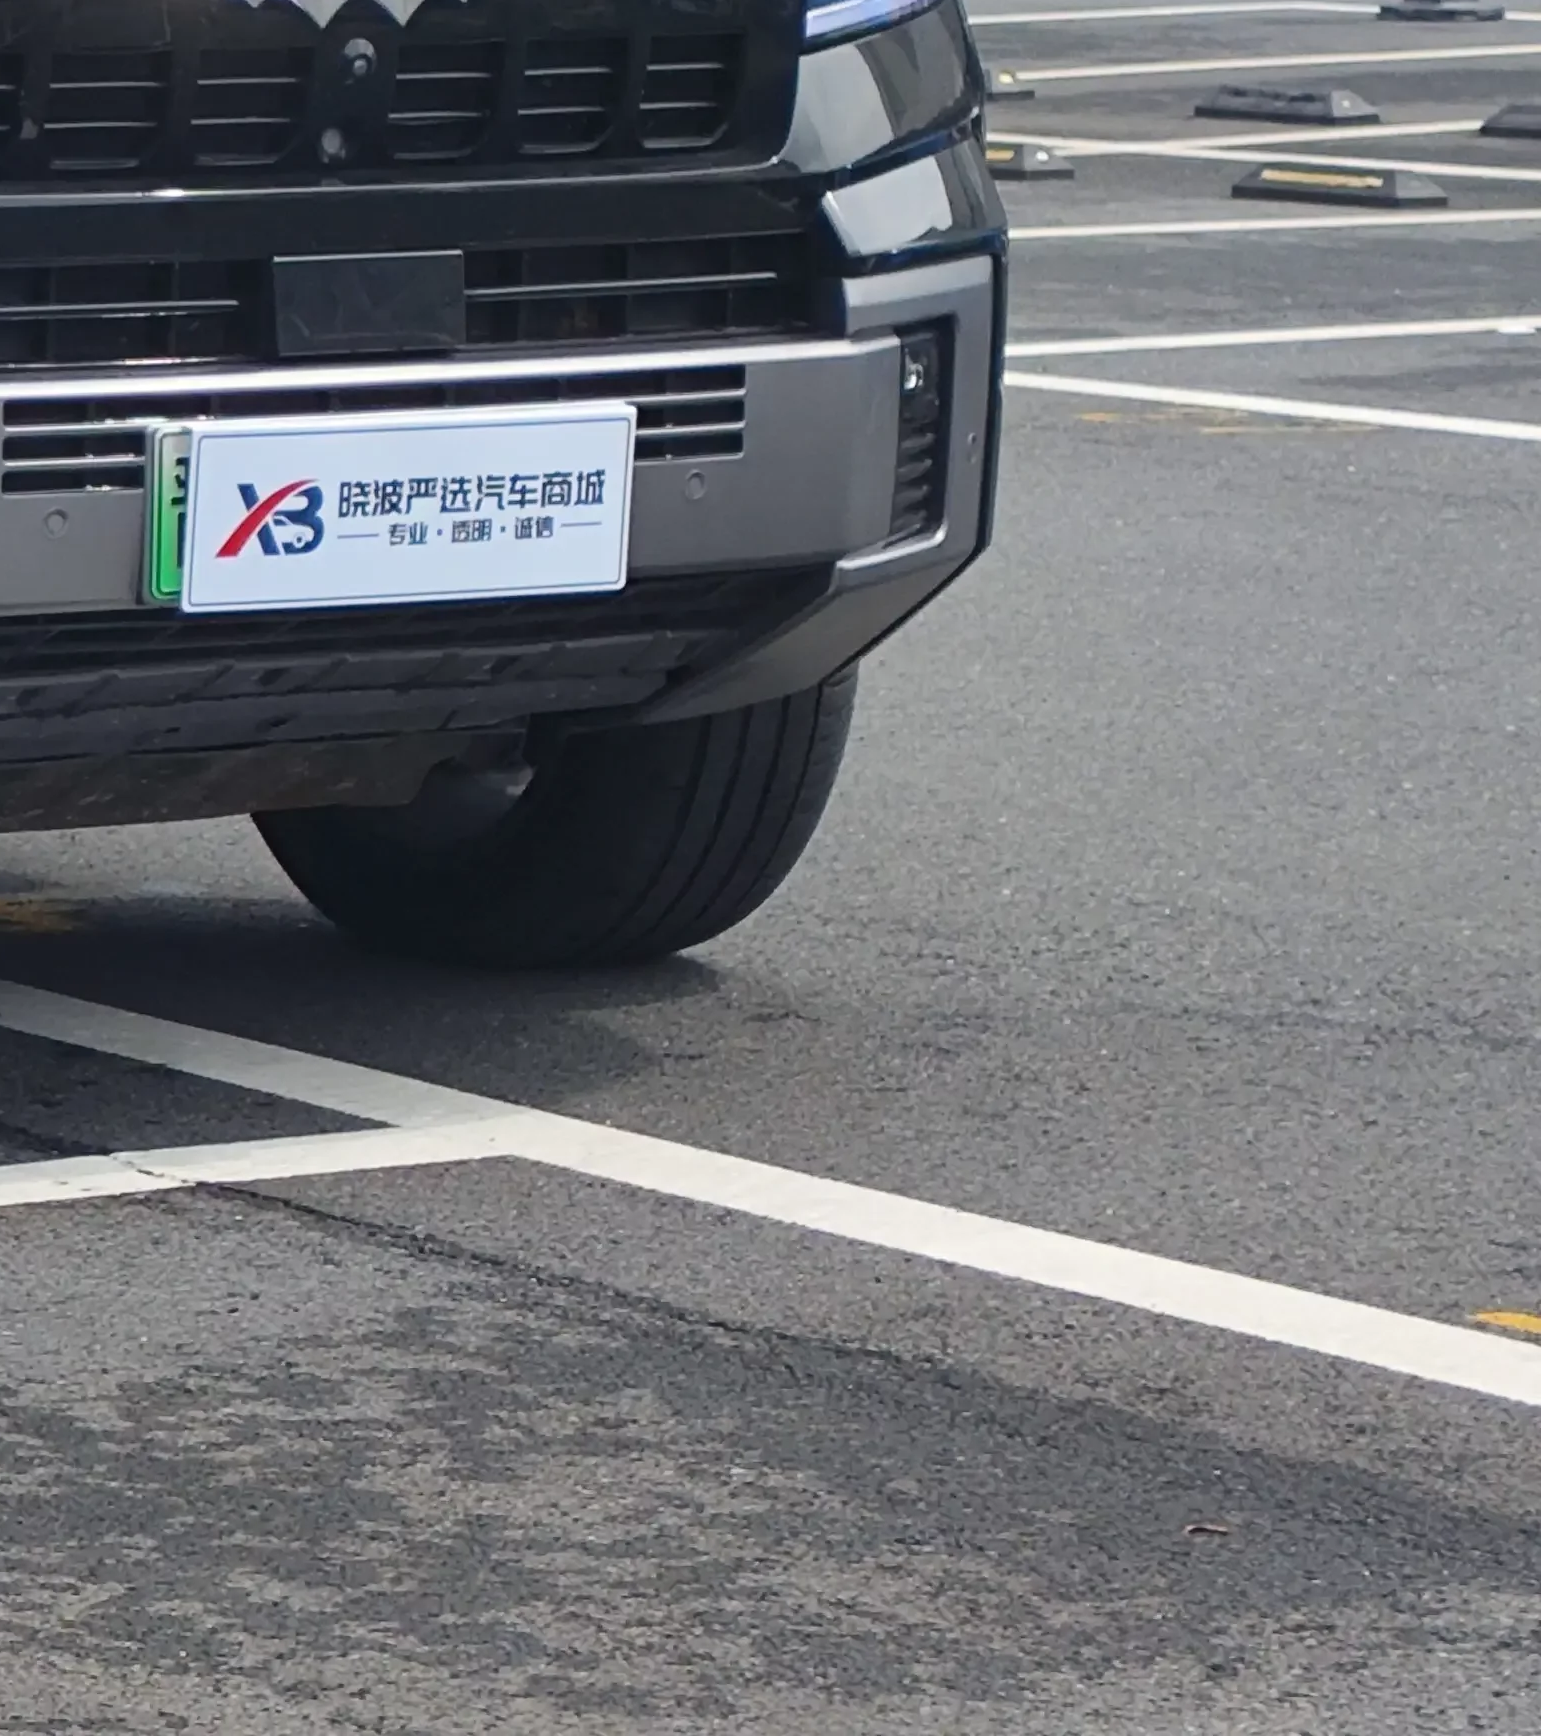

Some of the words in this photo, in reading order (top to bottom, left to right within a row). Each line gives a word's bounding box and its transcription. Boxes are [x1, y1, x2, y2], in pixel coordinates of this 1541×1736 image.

[337, 468, 606, 519] 晓波严选汽车商城
